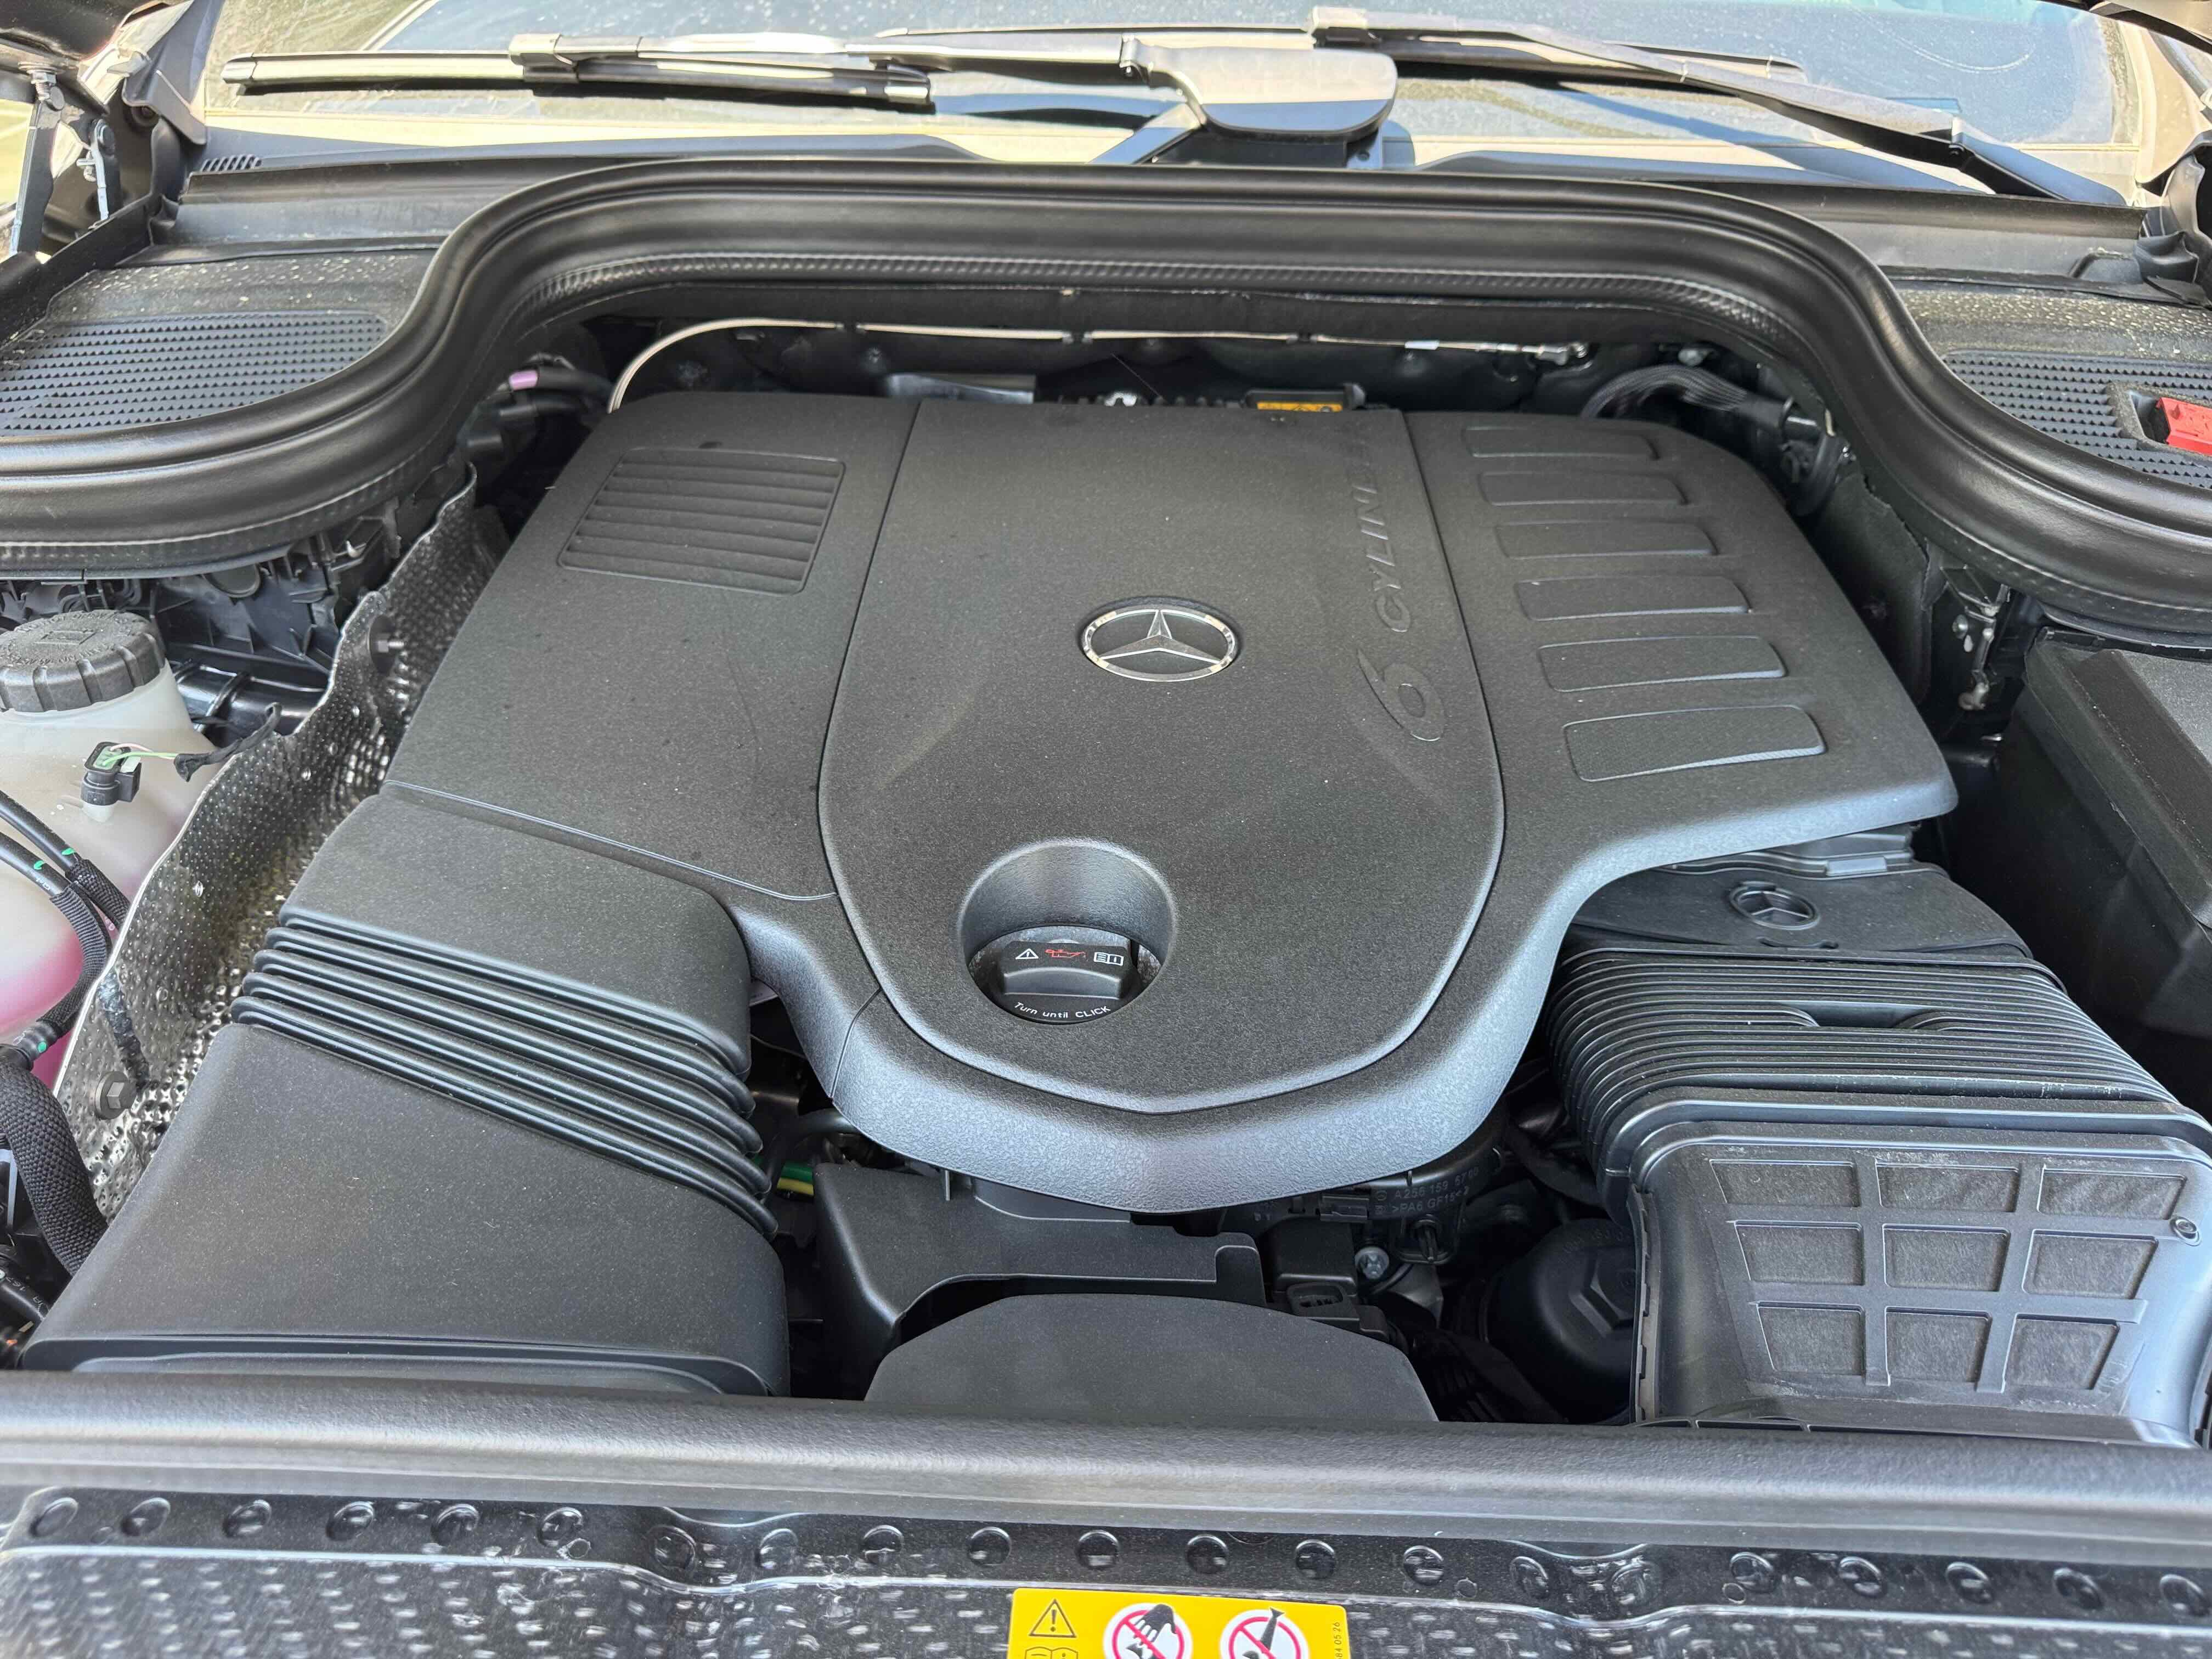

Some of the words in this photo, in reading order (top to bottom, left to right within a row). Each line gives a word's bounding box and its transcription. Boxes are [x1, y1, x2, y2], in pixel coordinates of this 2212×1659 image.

[1356, 647, 1447, 742] 6
[1014, 1002, 1039, 1015] Turn
[1042, 1011, 1069, 1019] until
[1075, 1005, 1111, 1018] CLICK
[1331, 1622, 1341, 1632] 26
[1334, 1634, 1342, 1645] 05
